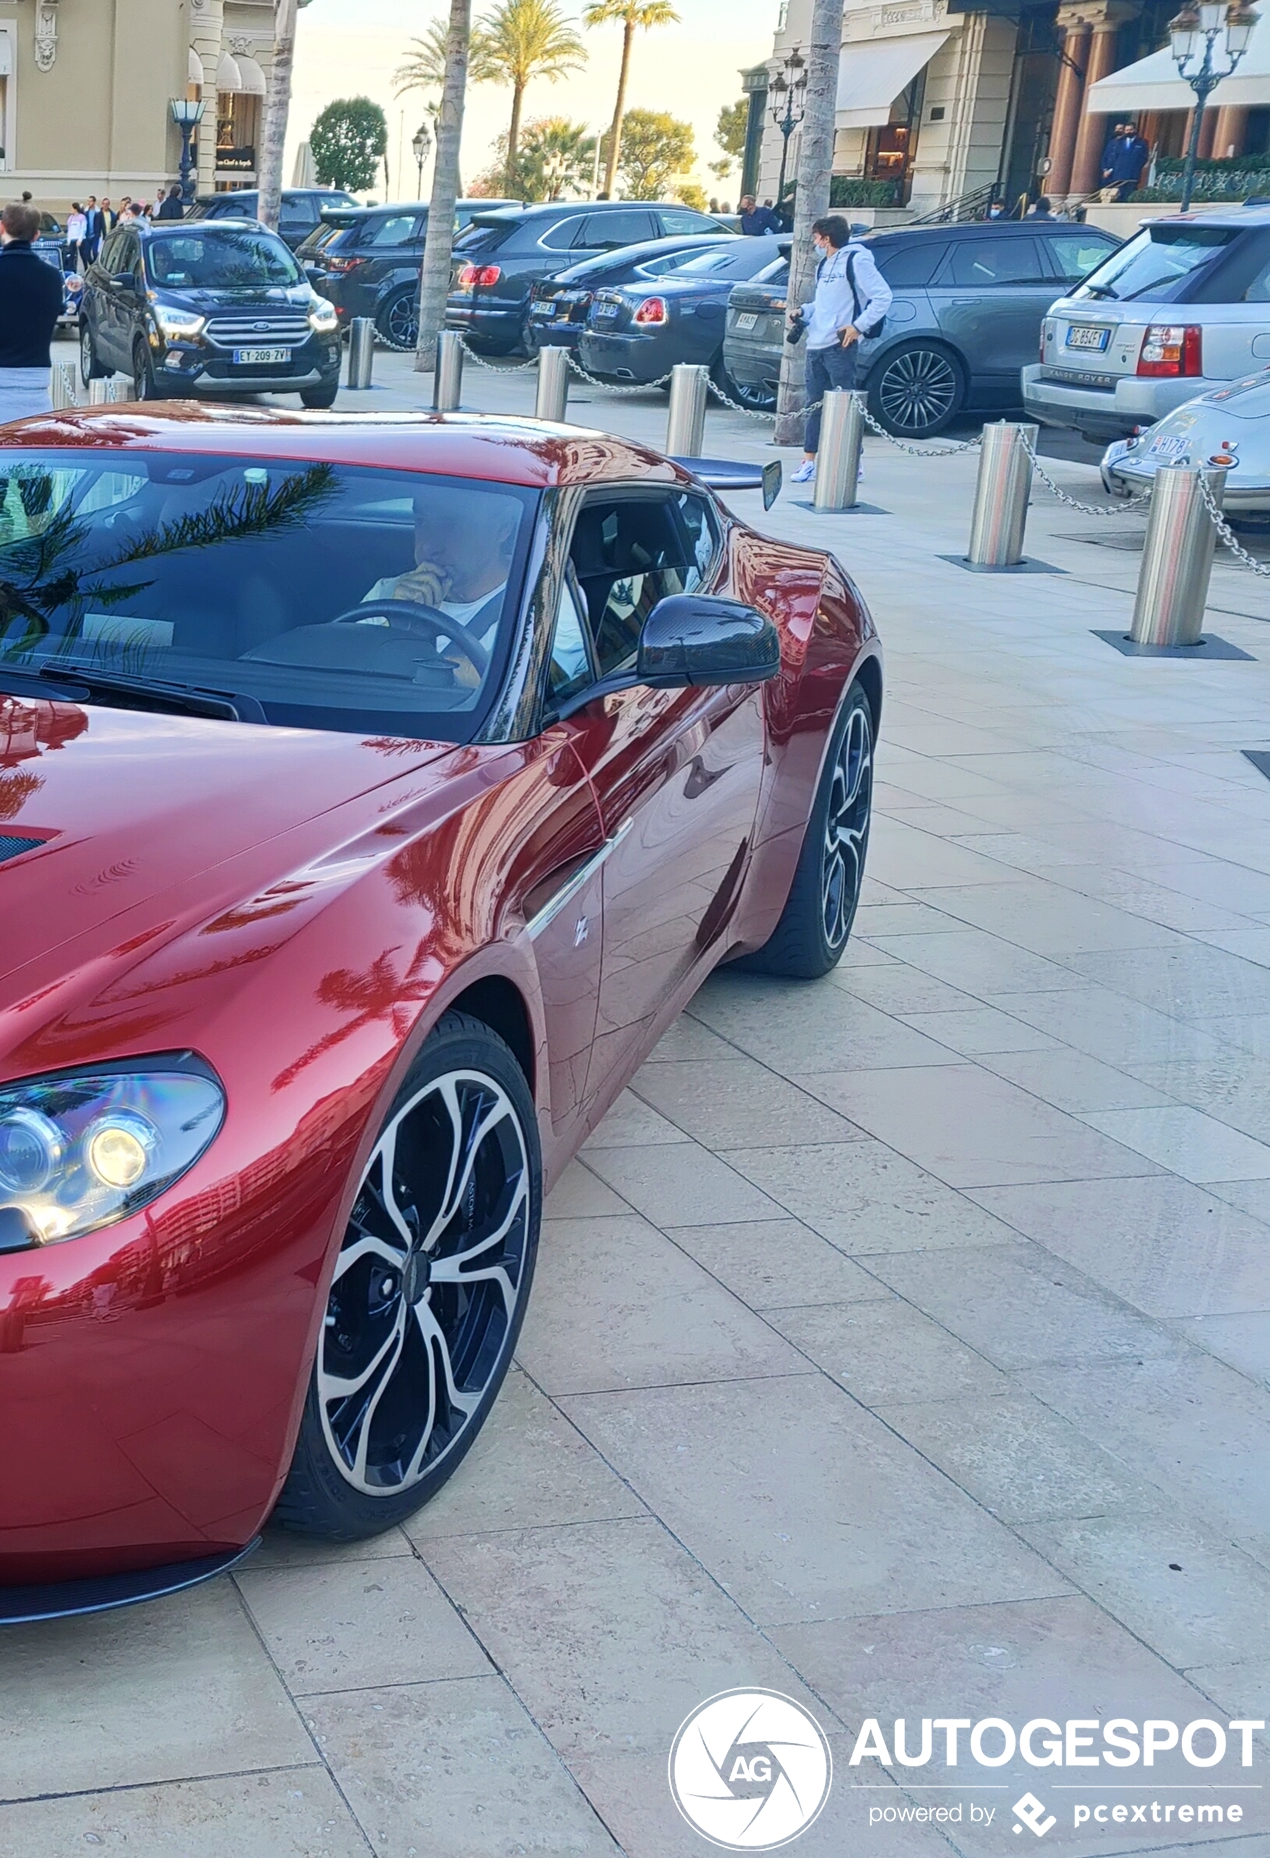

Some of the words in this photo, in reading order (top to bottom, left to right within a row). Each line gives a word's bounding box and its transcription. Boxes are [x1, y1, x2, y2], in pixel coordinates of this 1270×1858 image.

[1050, 369, 1074, 379] RANGE
[1077, 372, 1111, 384] ROVER
[1159, 436, 1186, 454] H178
